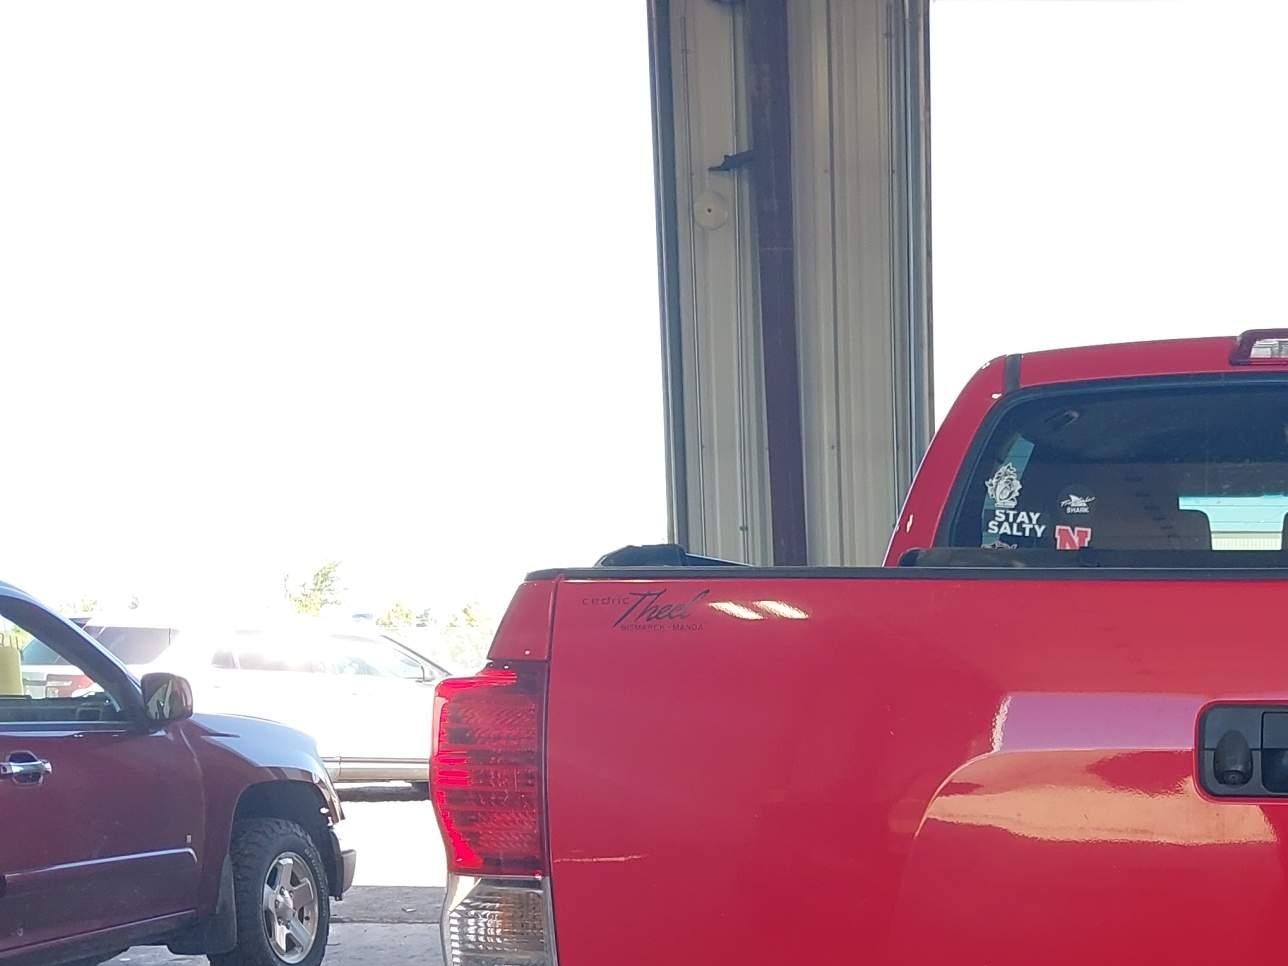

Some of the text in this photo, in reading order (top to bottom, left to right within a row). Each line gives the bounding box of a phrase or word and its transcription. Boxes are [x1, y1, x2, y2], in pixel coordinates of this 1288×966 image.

[995, 509, 1041, 524] STAY
[988, 521, 1046, 538] SALTY
[1055, 525, 1091, 550] N
